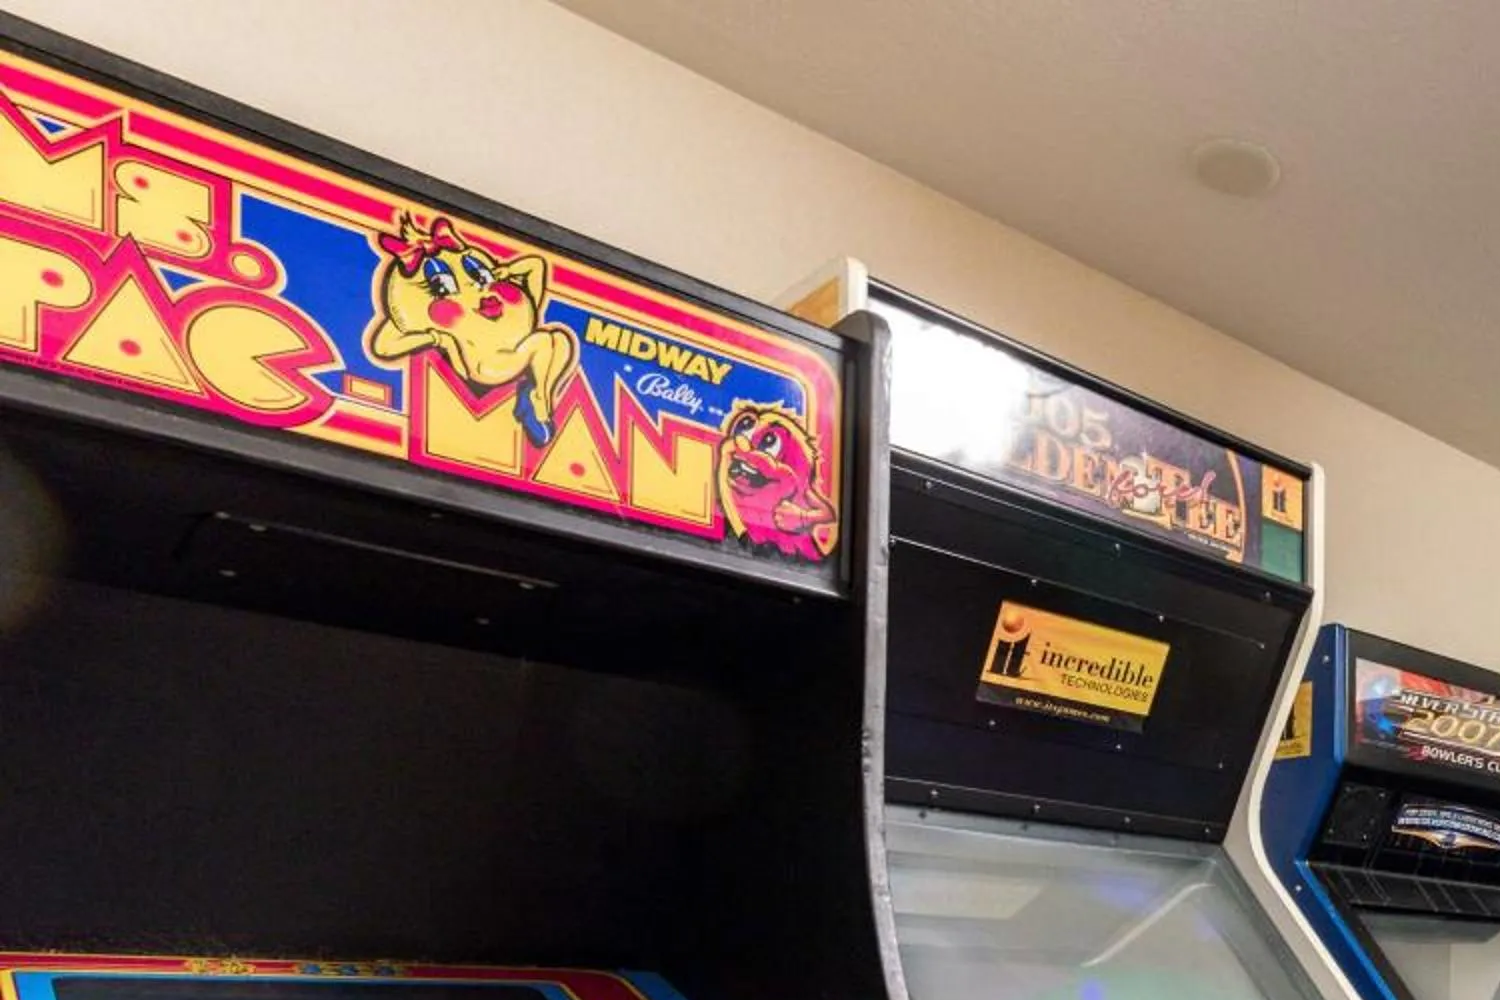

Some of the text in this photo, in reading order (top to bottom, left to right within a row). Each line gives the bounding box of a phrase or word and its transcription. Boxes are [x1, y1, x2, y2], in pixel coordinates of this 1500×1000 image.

[585, 317, 733, 385] MIDWAY
[636, 372, 704, 414] Bally
[1039, 641, 1153, 689] incredible
[1060, 672, 1149, 703] TECHNOLOGIES
[1421, 744, 1484, 770] BOWLER'S
